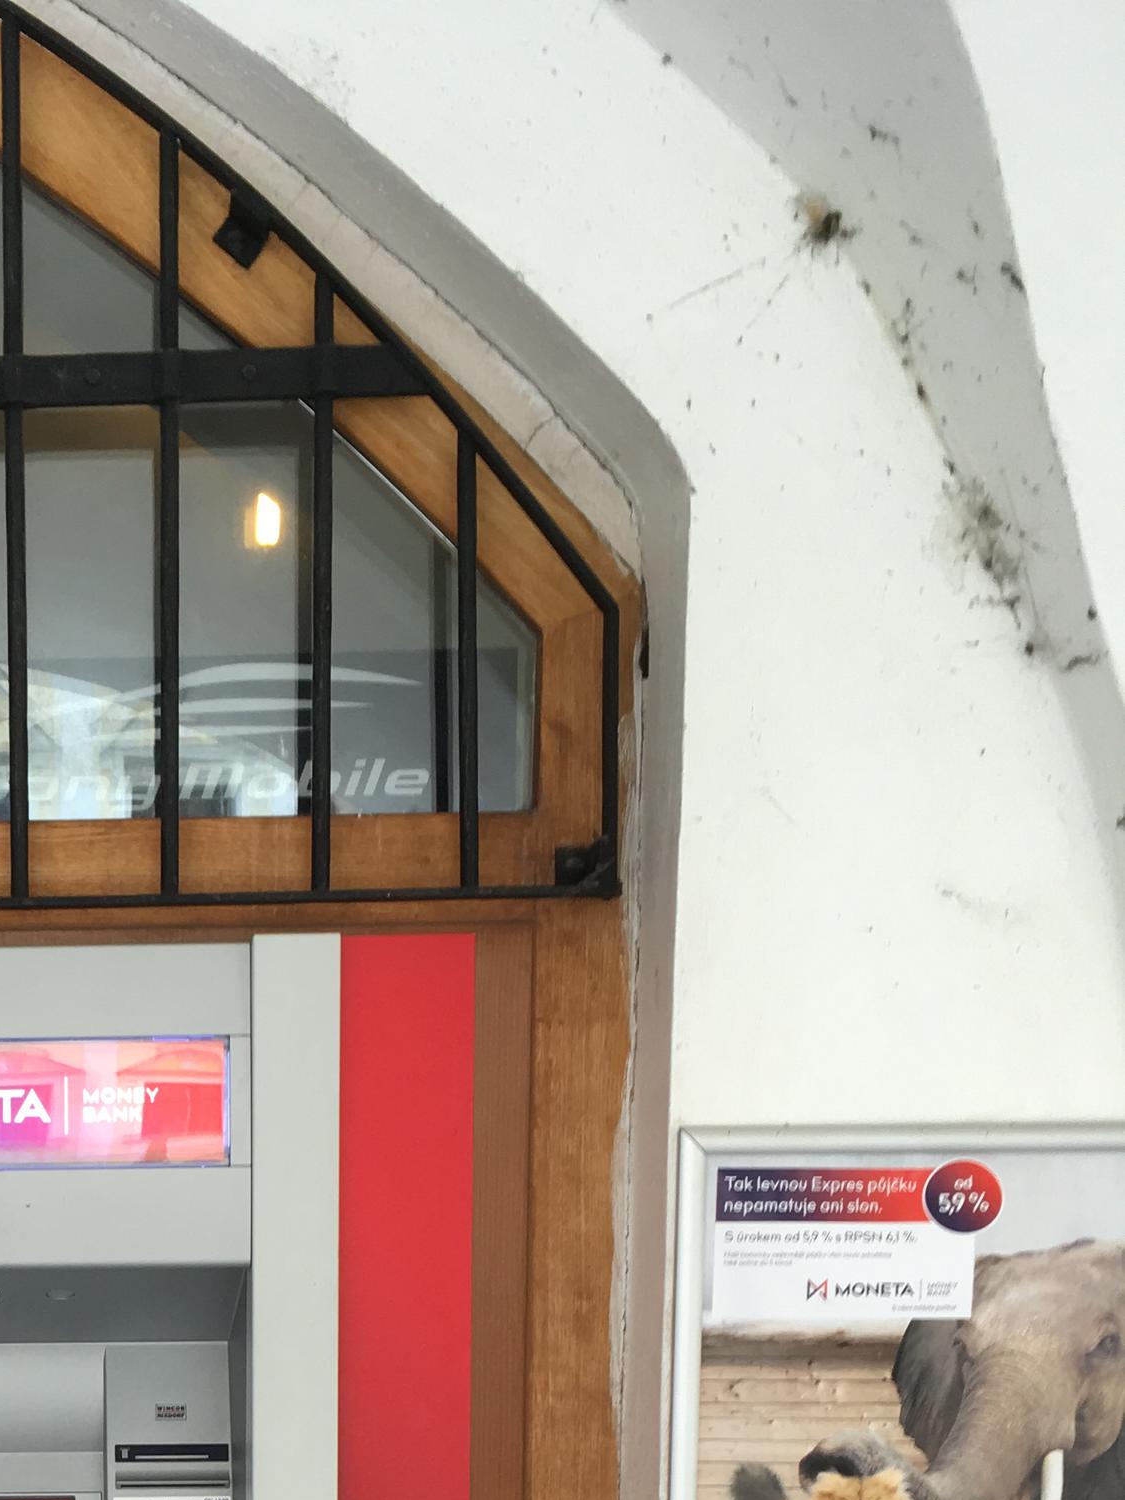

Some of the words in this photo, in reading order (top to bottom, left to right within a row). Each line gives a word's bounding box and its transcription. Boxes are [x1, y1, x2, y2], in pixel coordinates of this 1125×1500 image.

[82, 1086, 160, 1105] MONEY
[82, 1105, 144, 1124] BANK
[724, 1175, 753, 1192] Tak
[756, 1175, 808, 1192] levnou
[811, 1175, 863, 1196] Expres
[867, 1175, 917, 1197] půjčku
[953, 1174, 973, 1191] od
[724, 1197, 817, 1217] nepamatuje
[820, 1197, 843, 1214] ani
[938, 1191, 965, 1217] 5,9
[968, 1191, 990, 1214] %
[724, 1230, 734, 1243] S
[736, 1230, 782, 1243] úrokem
[784, 1230, 800, 1243] od
[802, 1230, 819, 1246] 5,9
[821, 1230, 833, 1243] %
[834, 1281, 915, 1298] MONETA
